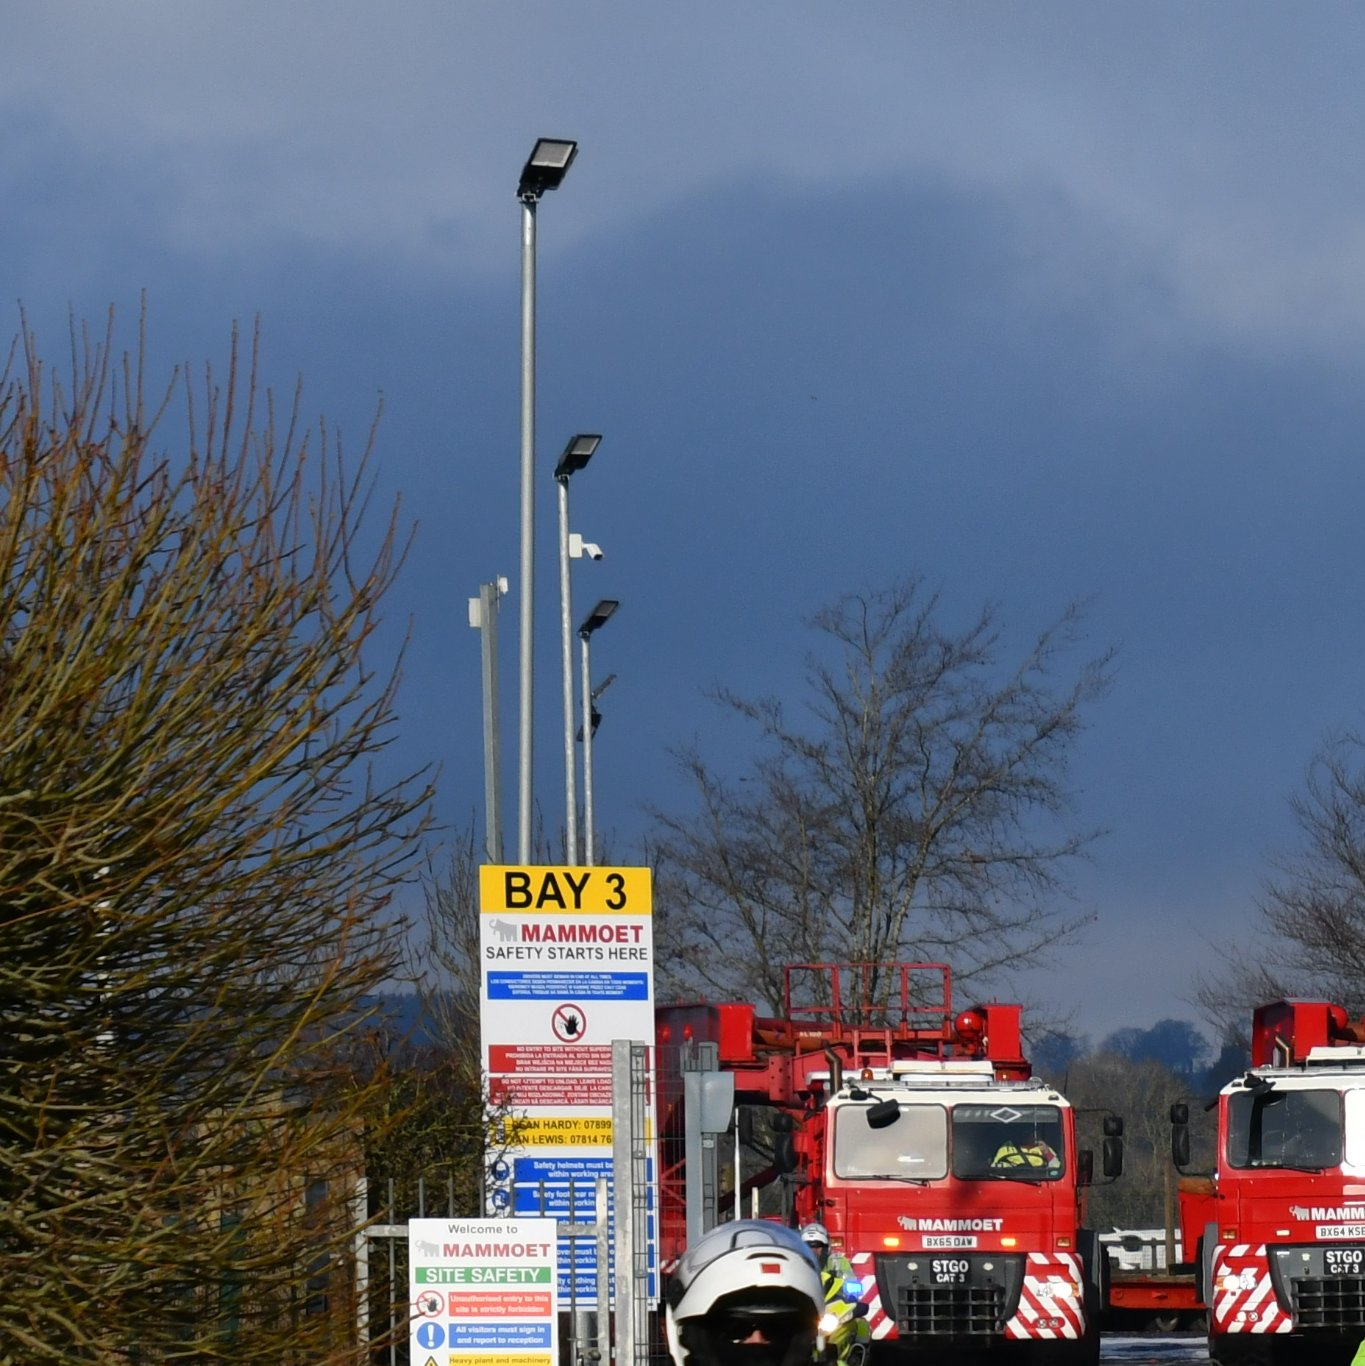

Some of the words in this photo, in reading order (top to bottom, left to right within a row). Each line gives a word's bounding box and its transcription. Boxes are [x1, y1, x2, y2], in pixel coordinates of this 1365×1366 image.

[505, 871, 591, 909] BAY
[605, 873, 627, 910] 3
[521, 923, 643, 943] MAMMOET
[486, 946, 543, 959] SAFETY
[547, 947, 603, 960] STARTS
[609, 947, 648, 960] HERE
[448, 1224, 502, 1234] Welcome
[506, 1224, 518, 1234] to
[918, 1218, 1003, 1231] MAMMOET
[1320, 1228, 1345, 1236] BX64
[926, 1237, 952, 1246] BX65
[443, 1243, 551, 1257] MAMMOET
[1326, 1250, 1362, 1263] STGO
[932, 1260, 969, 1272] STGO
[1352, 1264, 1359, 1273] 3
[426, 1268, 465, 1282] SITE
[471, 1268, 540, 1282] SAFETY
[936, 1274, 956, 1283] CAT
[959, 1274, 965, 1282] 3
[519, 1326, 538, 1335] sign
[508, 1337, 544, 1345] reception
